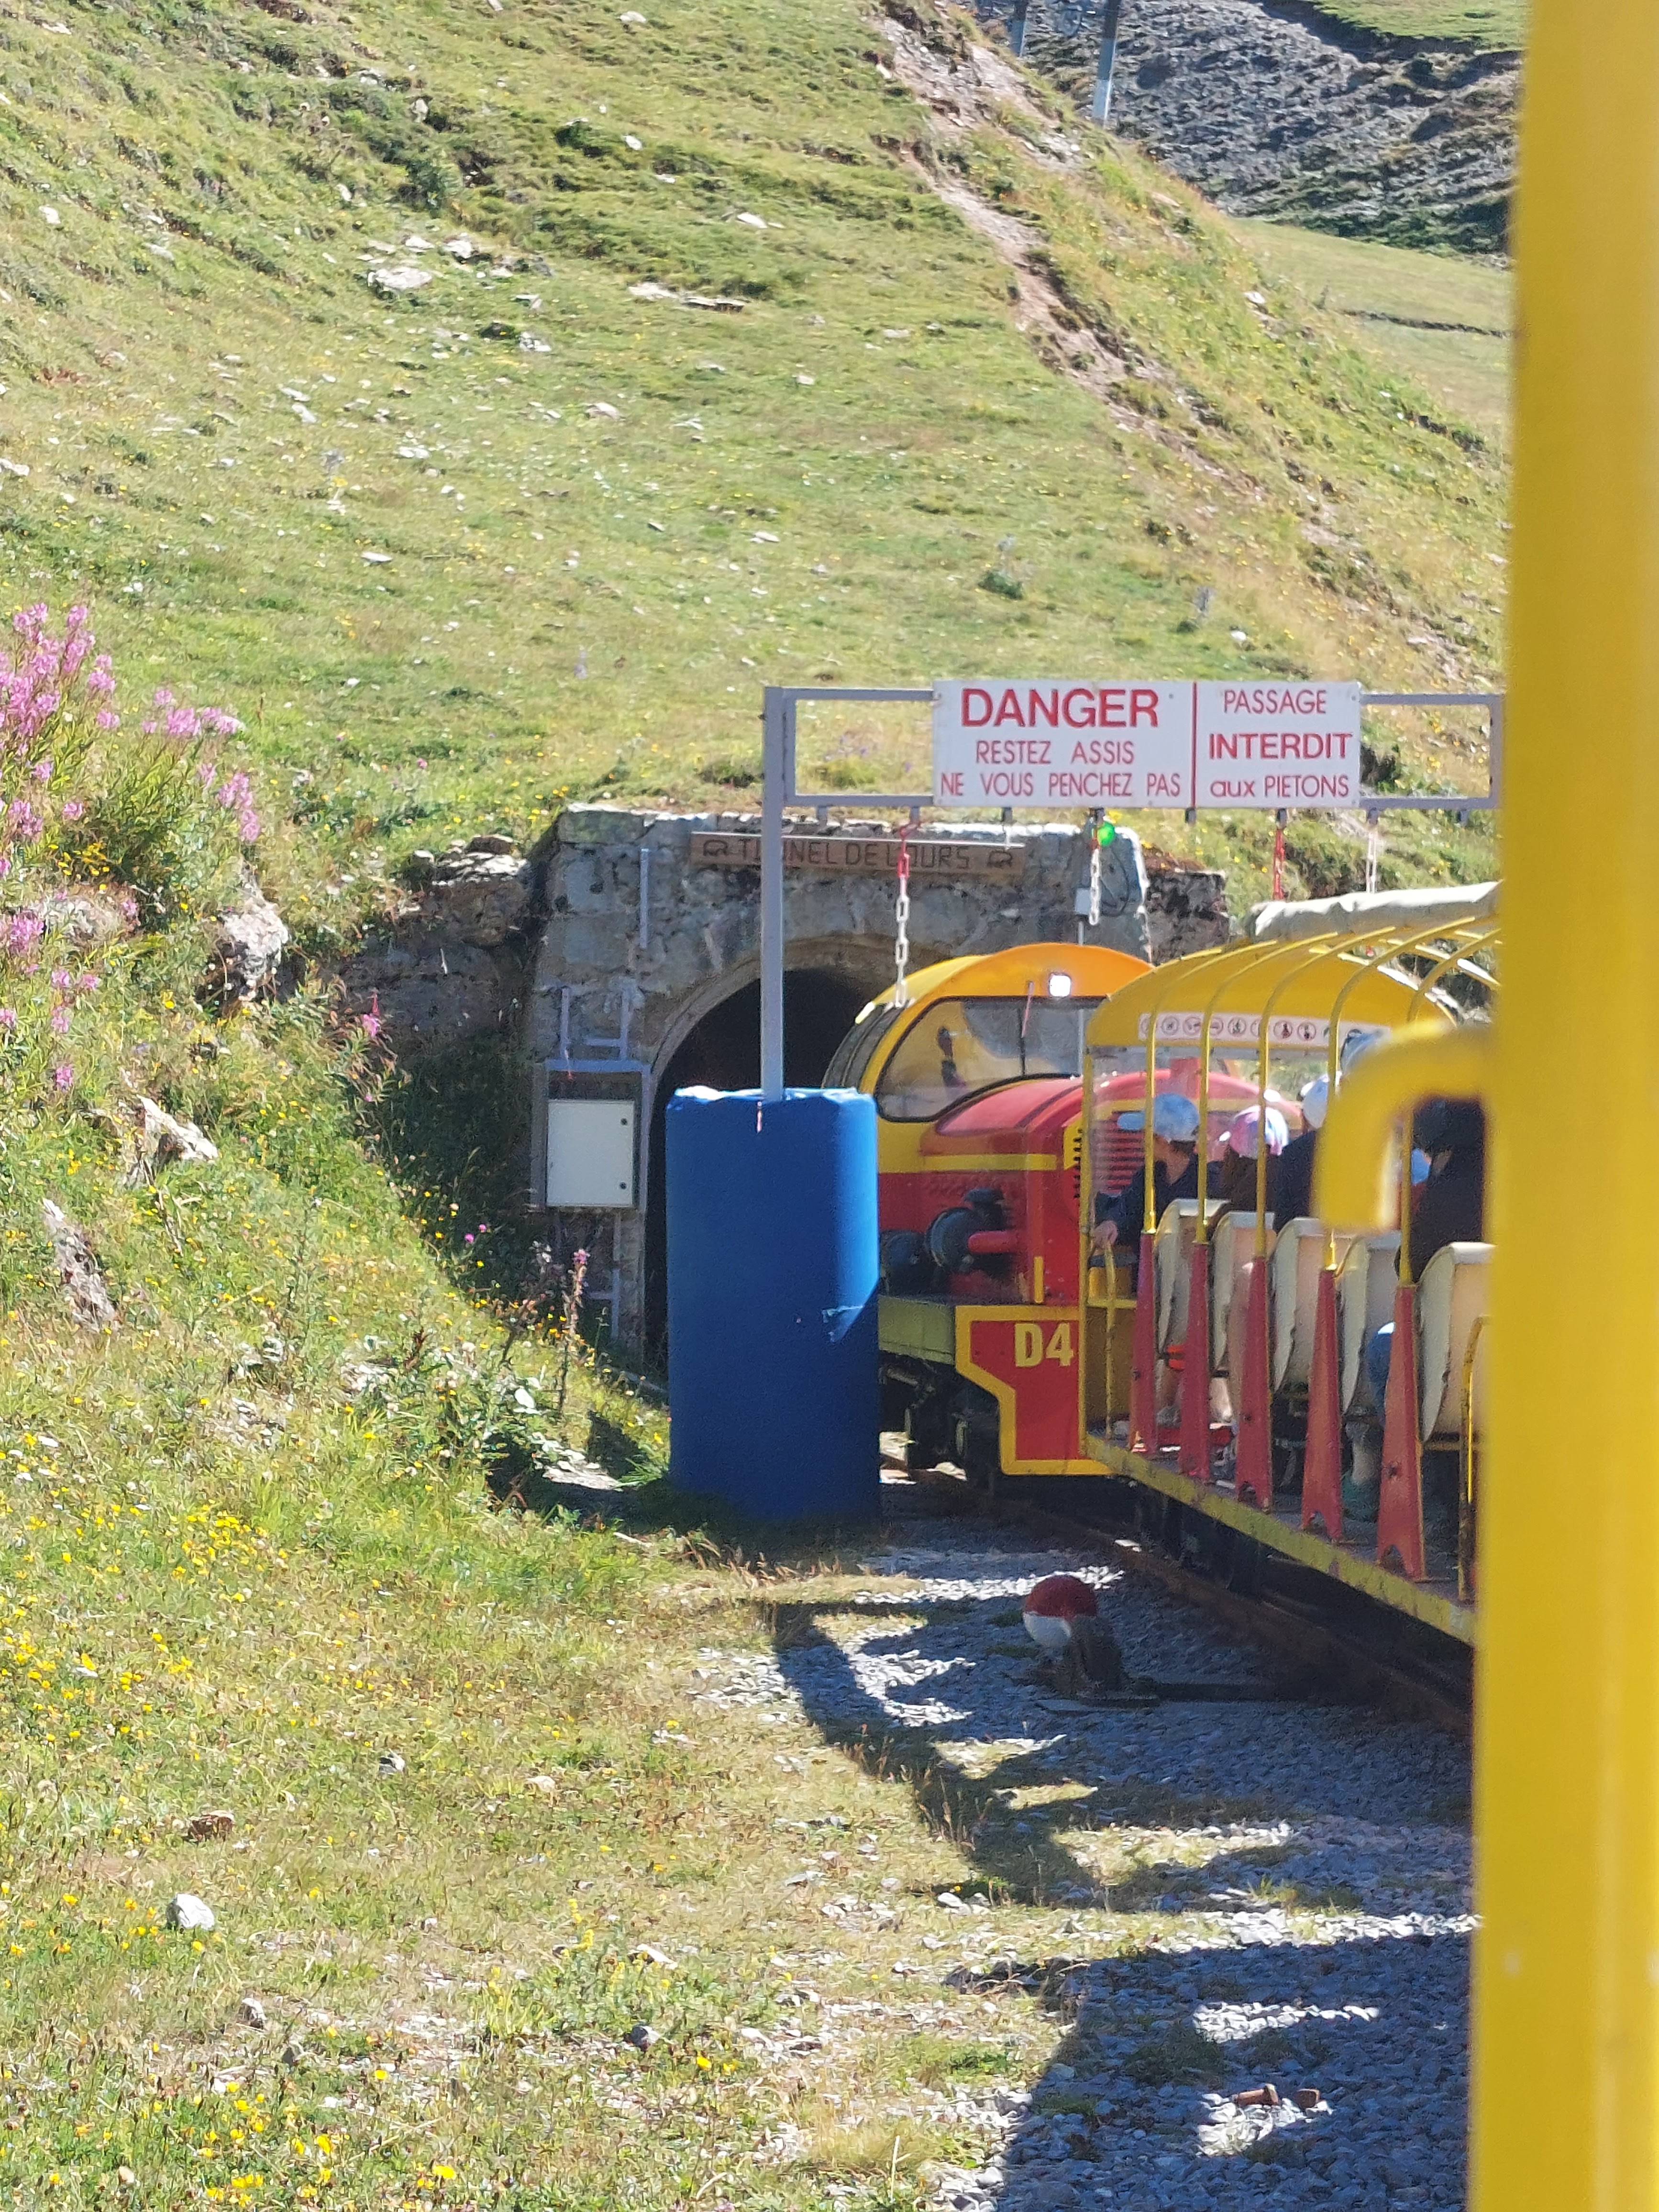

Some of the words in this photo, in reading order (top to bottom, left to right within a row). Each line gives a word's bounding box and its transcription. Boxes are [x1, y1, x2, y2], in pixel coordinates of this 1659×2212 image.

[961, 687, 1160, 729] DANGER
[1223, 689, 1327, 715] PASSAGE
[975, 740, 1051, 765] RESTEZ
[1071, 740, 1135, 765] ASSIS
[1208, 732, 1352, 760] INTERDIT
[940, 772, 964, 796] NE
[980, 772, 1034, 796] VOUS
[1049, 772, 1133, 797] PENCHEZ
[1146, 772, 1181, 797] PAS
[1209, 779, 1256, 798] aux
[1264, 774, 1350, 798] PIETONS
[739, 838, 837, 864] TNEL
[1014, 1323, 1073, 1367] D4
